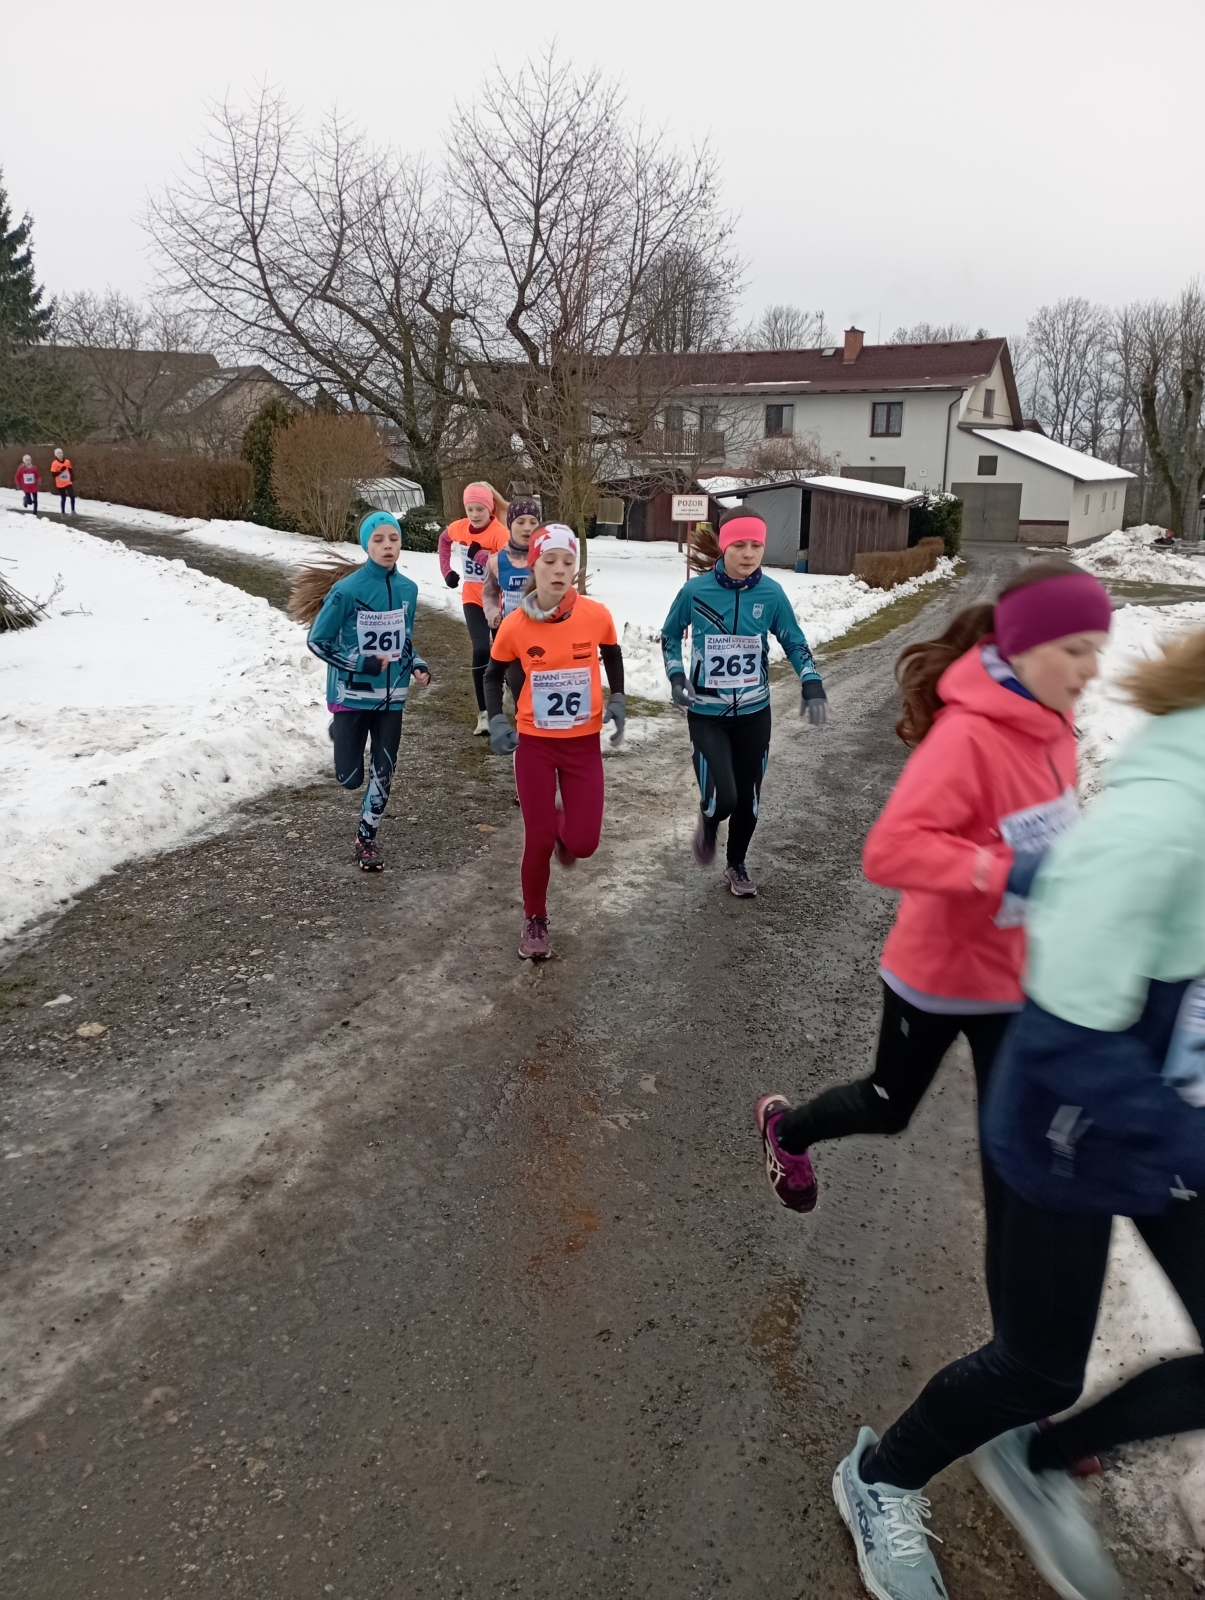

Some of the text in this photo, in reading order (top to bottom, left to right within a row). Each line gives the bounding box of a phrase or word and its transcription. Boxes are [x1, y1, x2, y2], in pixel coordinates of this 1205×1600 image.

[677, 499, 703, 507] POZOR
[465, 561, 484, 576] 58
[363, 630, 400, 651] 261
[707, 636, 731, 644] ZIMNÍ
[710, 653, 757, 677] 263
[533, 672, 559, 681] ZIMNÍ
[547, 692, 581, 717] 26
[856, 1501, 875, 1555] HOKA
